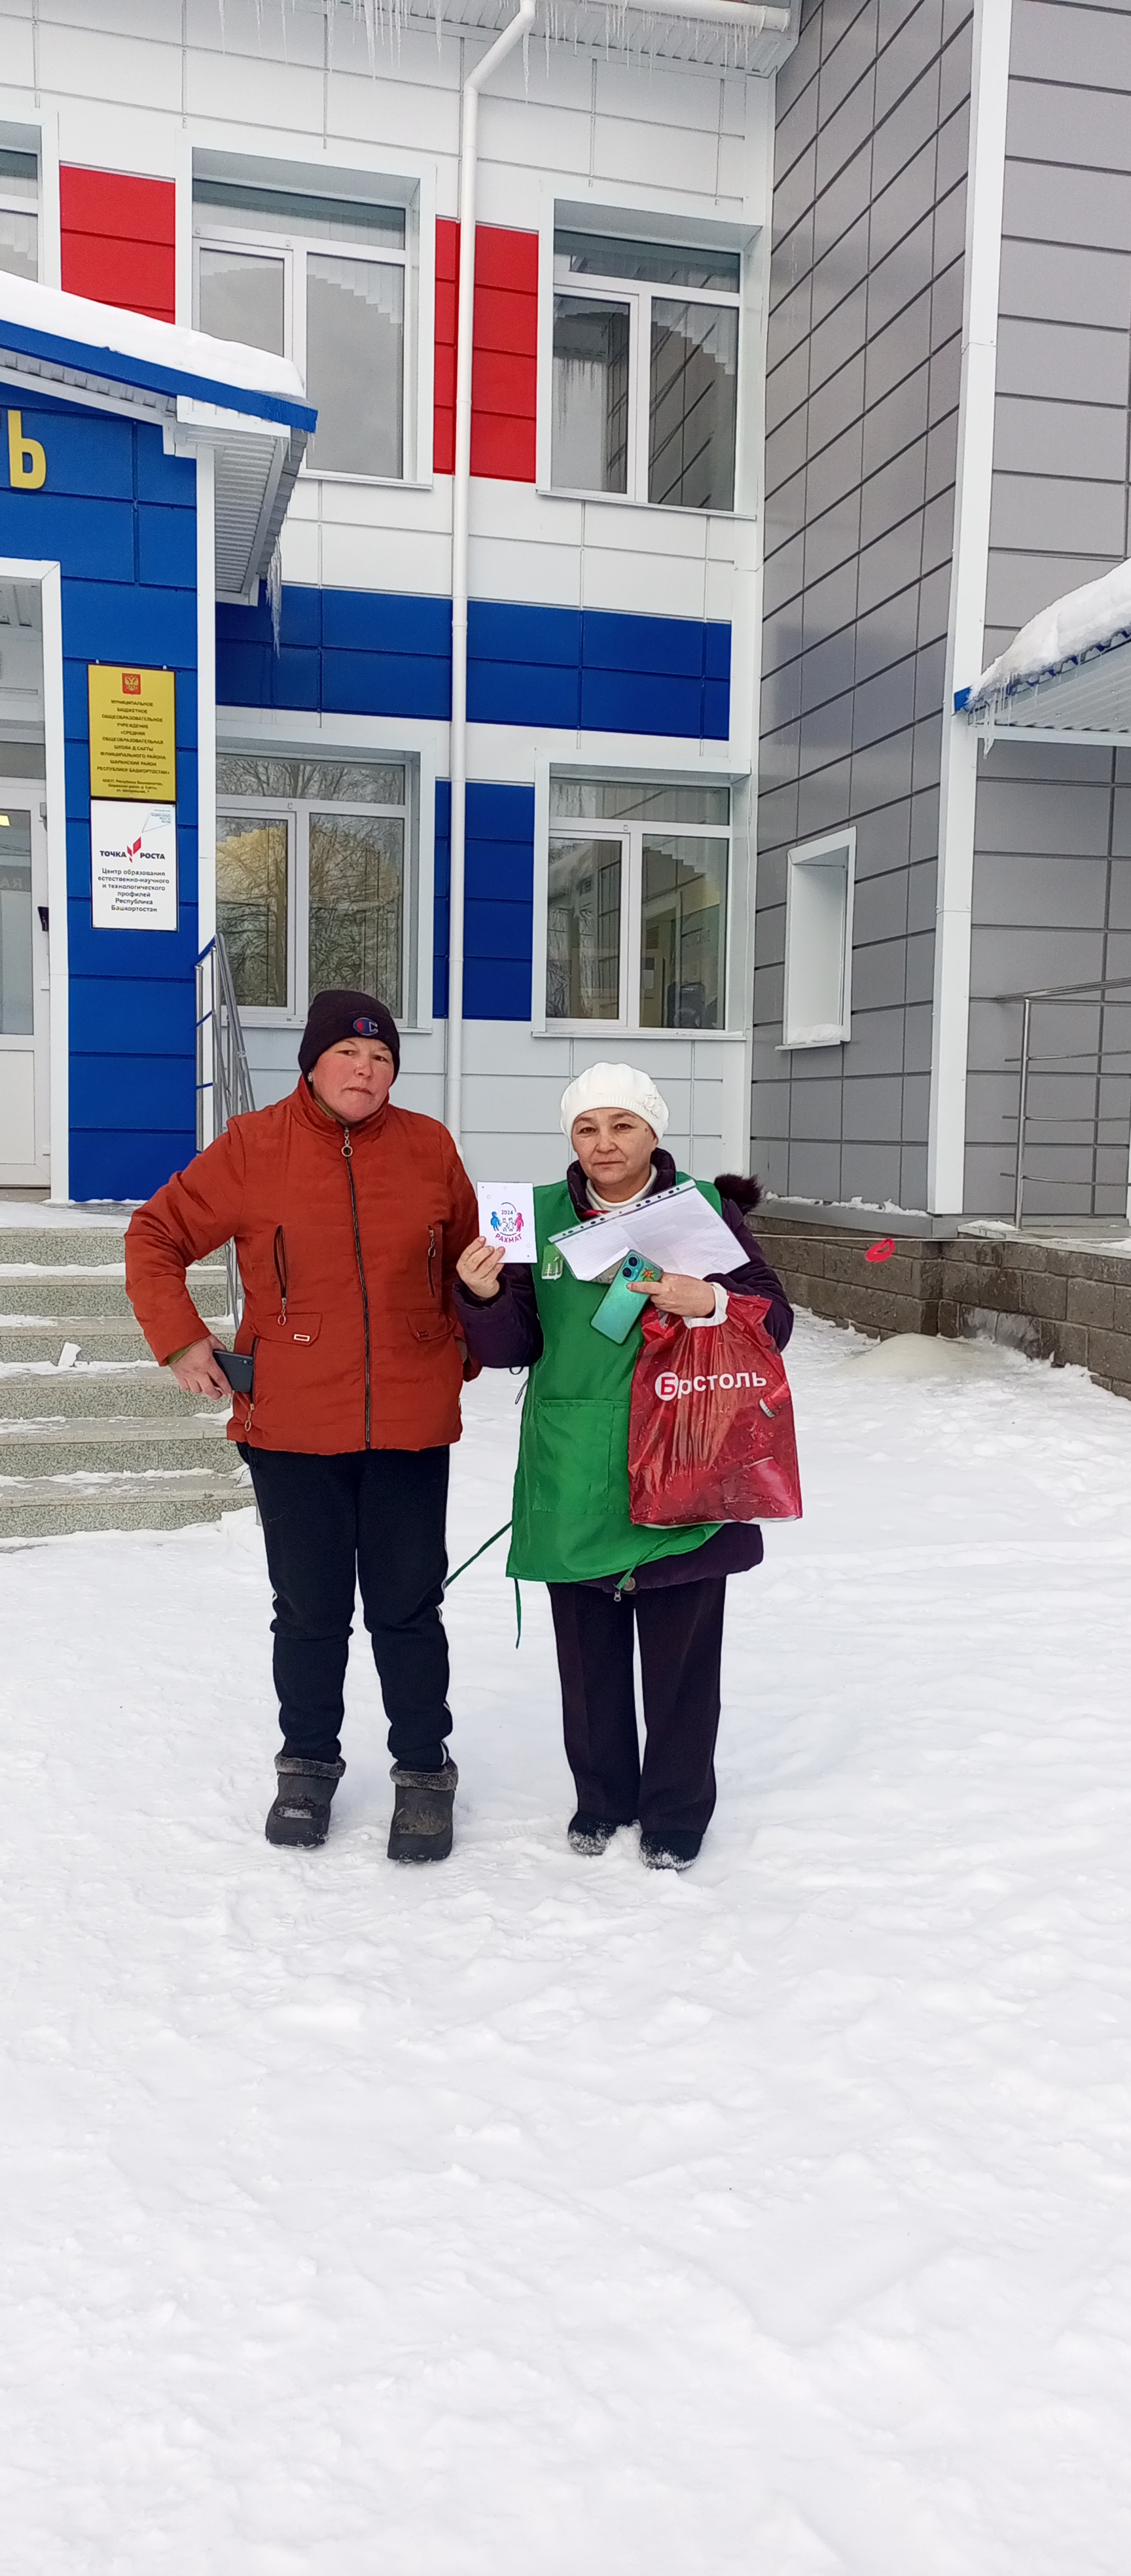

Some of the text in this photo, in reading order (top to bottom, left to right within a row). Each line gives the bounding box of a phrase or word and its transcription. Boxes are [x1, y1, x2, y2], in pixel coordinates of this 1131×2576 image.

[98, 876, 170, 884] естественно-научного
[495, 1233, 522, 1243] РАХМАТ
[660, 1372, 767, 1399] Брстоль
